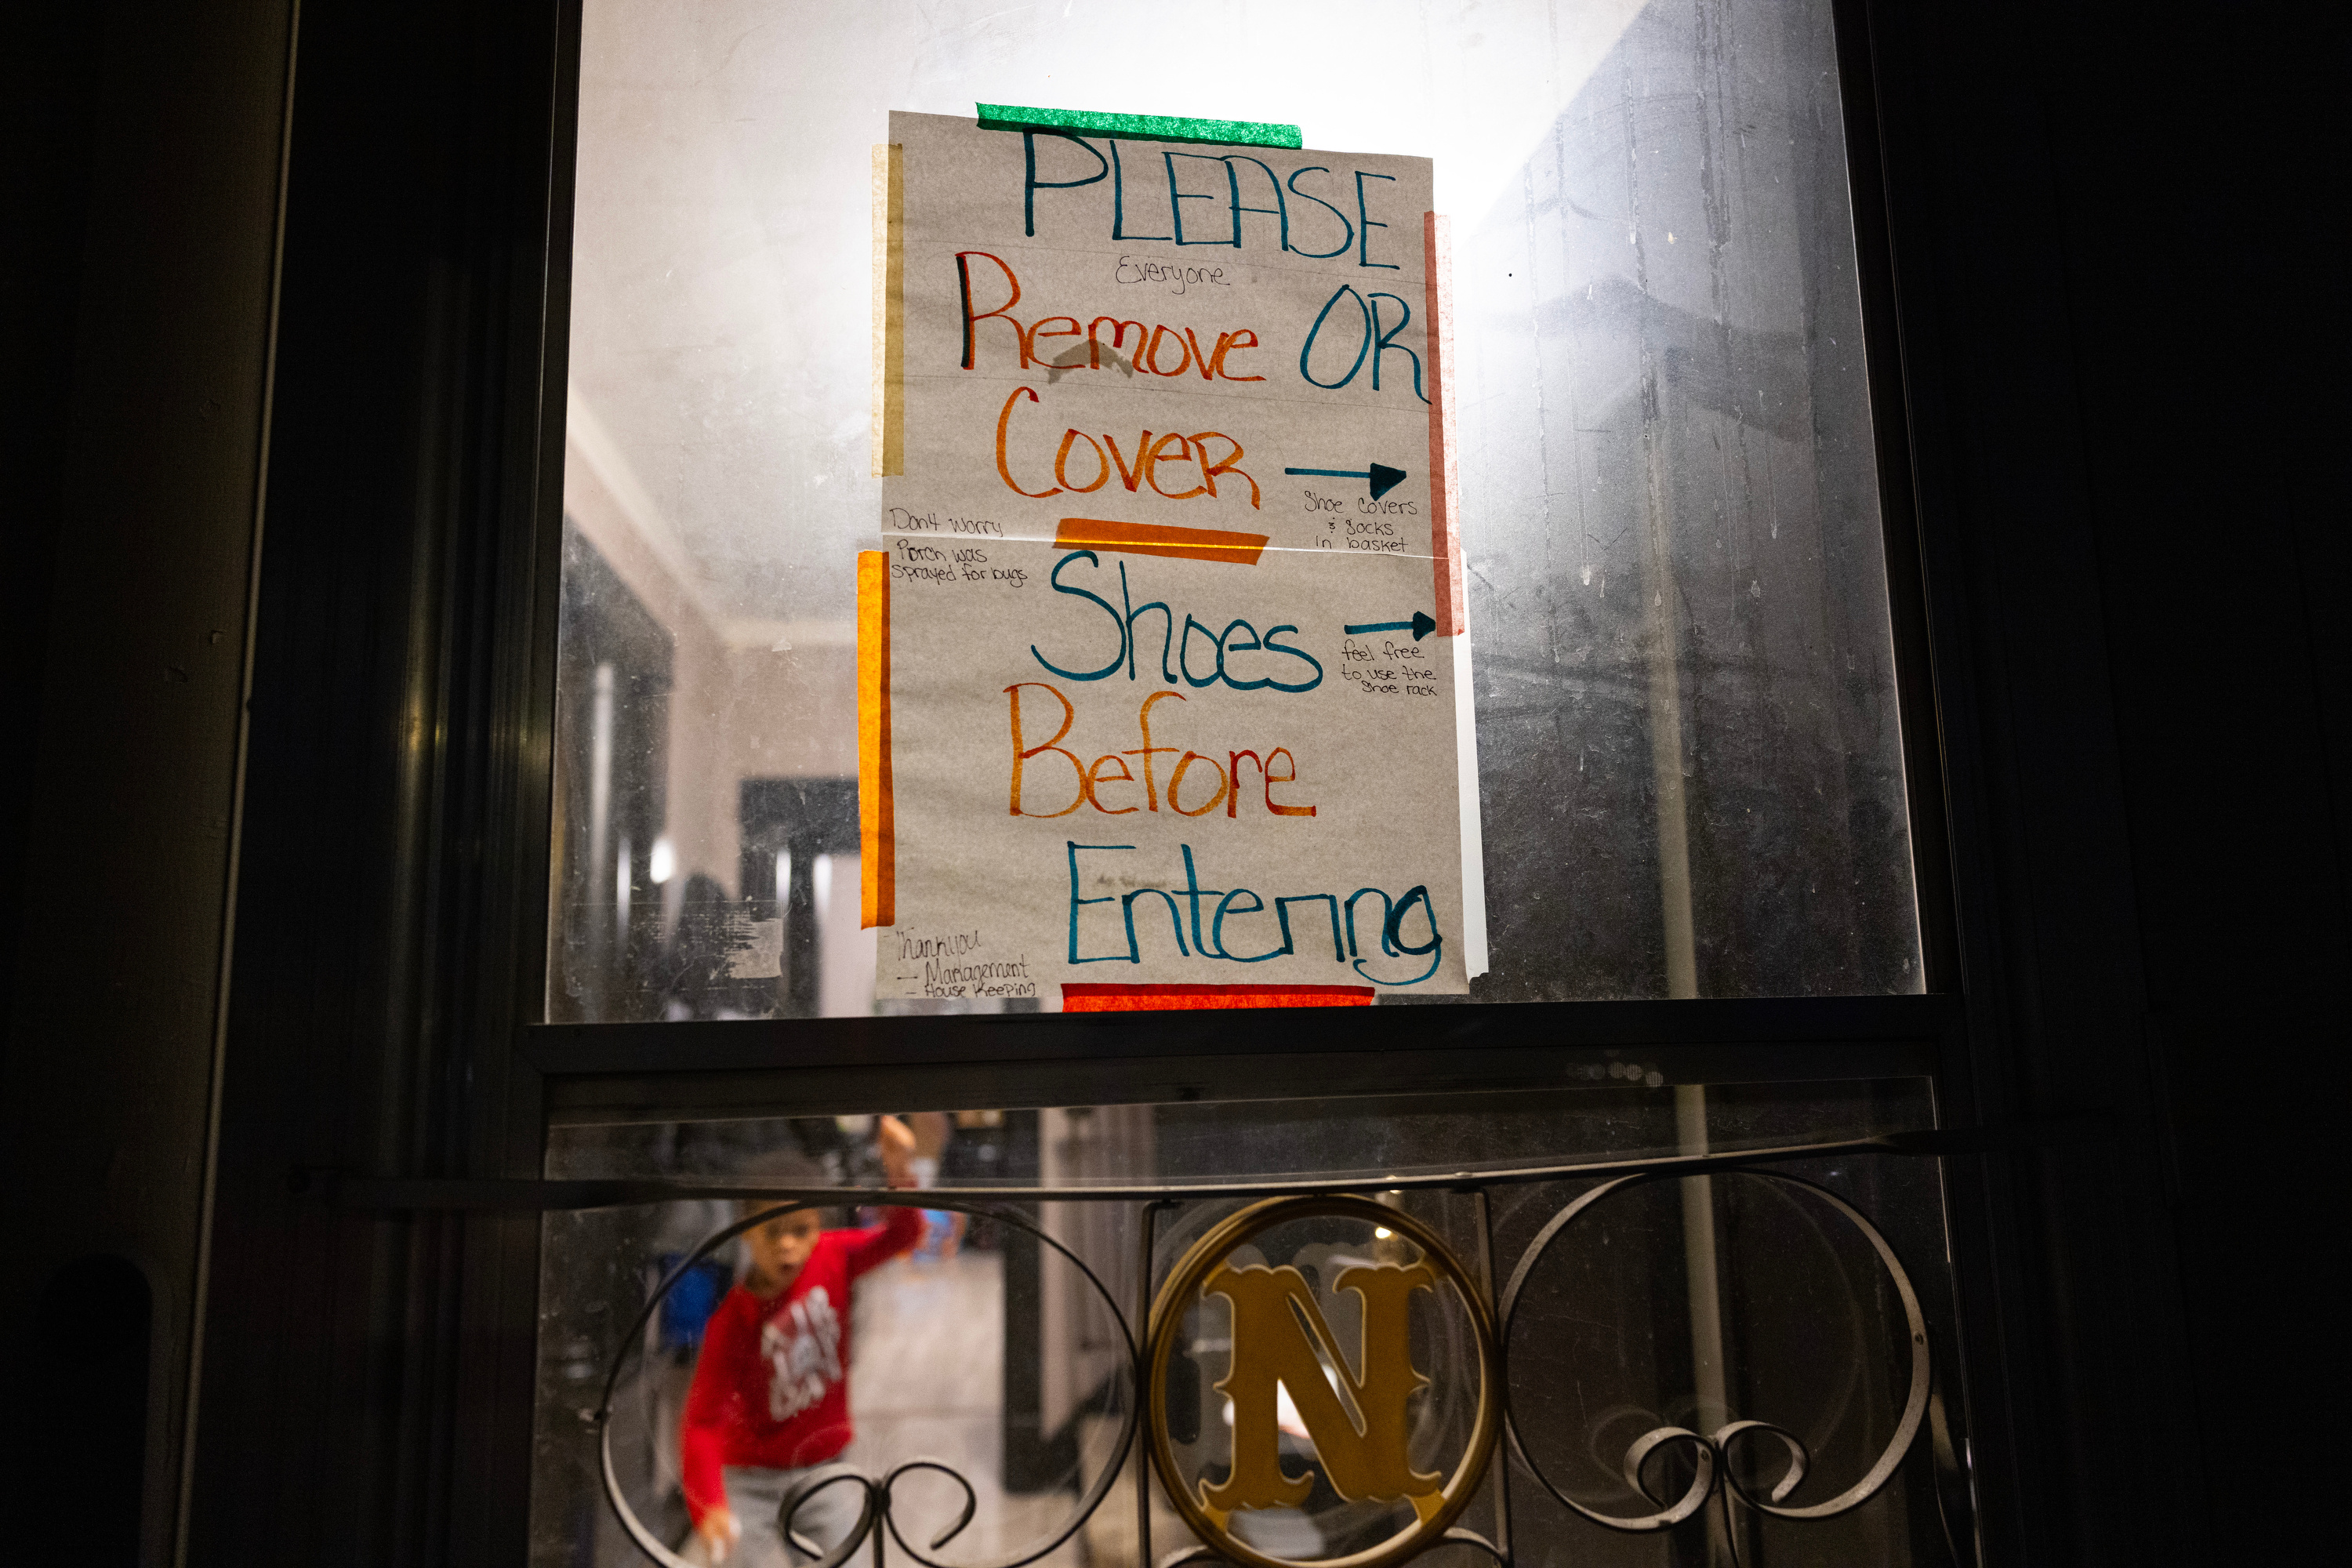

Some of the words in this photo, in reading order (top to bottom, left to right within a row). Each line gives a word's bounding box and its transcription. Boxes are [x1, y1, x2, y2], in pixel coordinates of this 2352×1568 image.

[1022, 126, 1400, 270] PLEASE
[1116, 256, 1230, 295] Everyone
[954, 251, 1268, 383] Remove
[1300, 284, 1432, 405] OR
[897, 539, 947, 561] Porch
[952, 548, 988, 563] was
[1347, 537, 1409, 552] basket
[962, 563, 987, 581] for
[991, 567, 1028, 588] bugs
[1031, 550, 1323, 693] Shoes
[1341, 639, 1374, 662] feel
[1383, 641, 1425, 660] free
[1341, 664, 1362, 681] to
[1367, 670, 1397, 681] use
[1402, 666, 1437, 681] the
[1406, 684, 1438, 696] rack
[1003, 682, 1317, 818] Before
[1067, 840, 1443, 986] Entering
[925, 953, 1030, 985] Management
[925, 983, 966, 998] House
[1199, 1264, 1442, 1512] N
